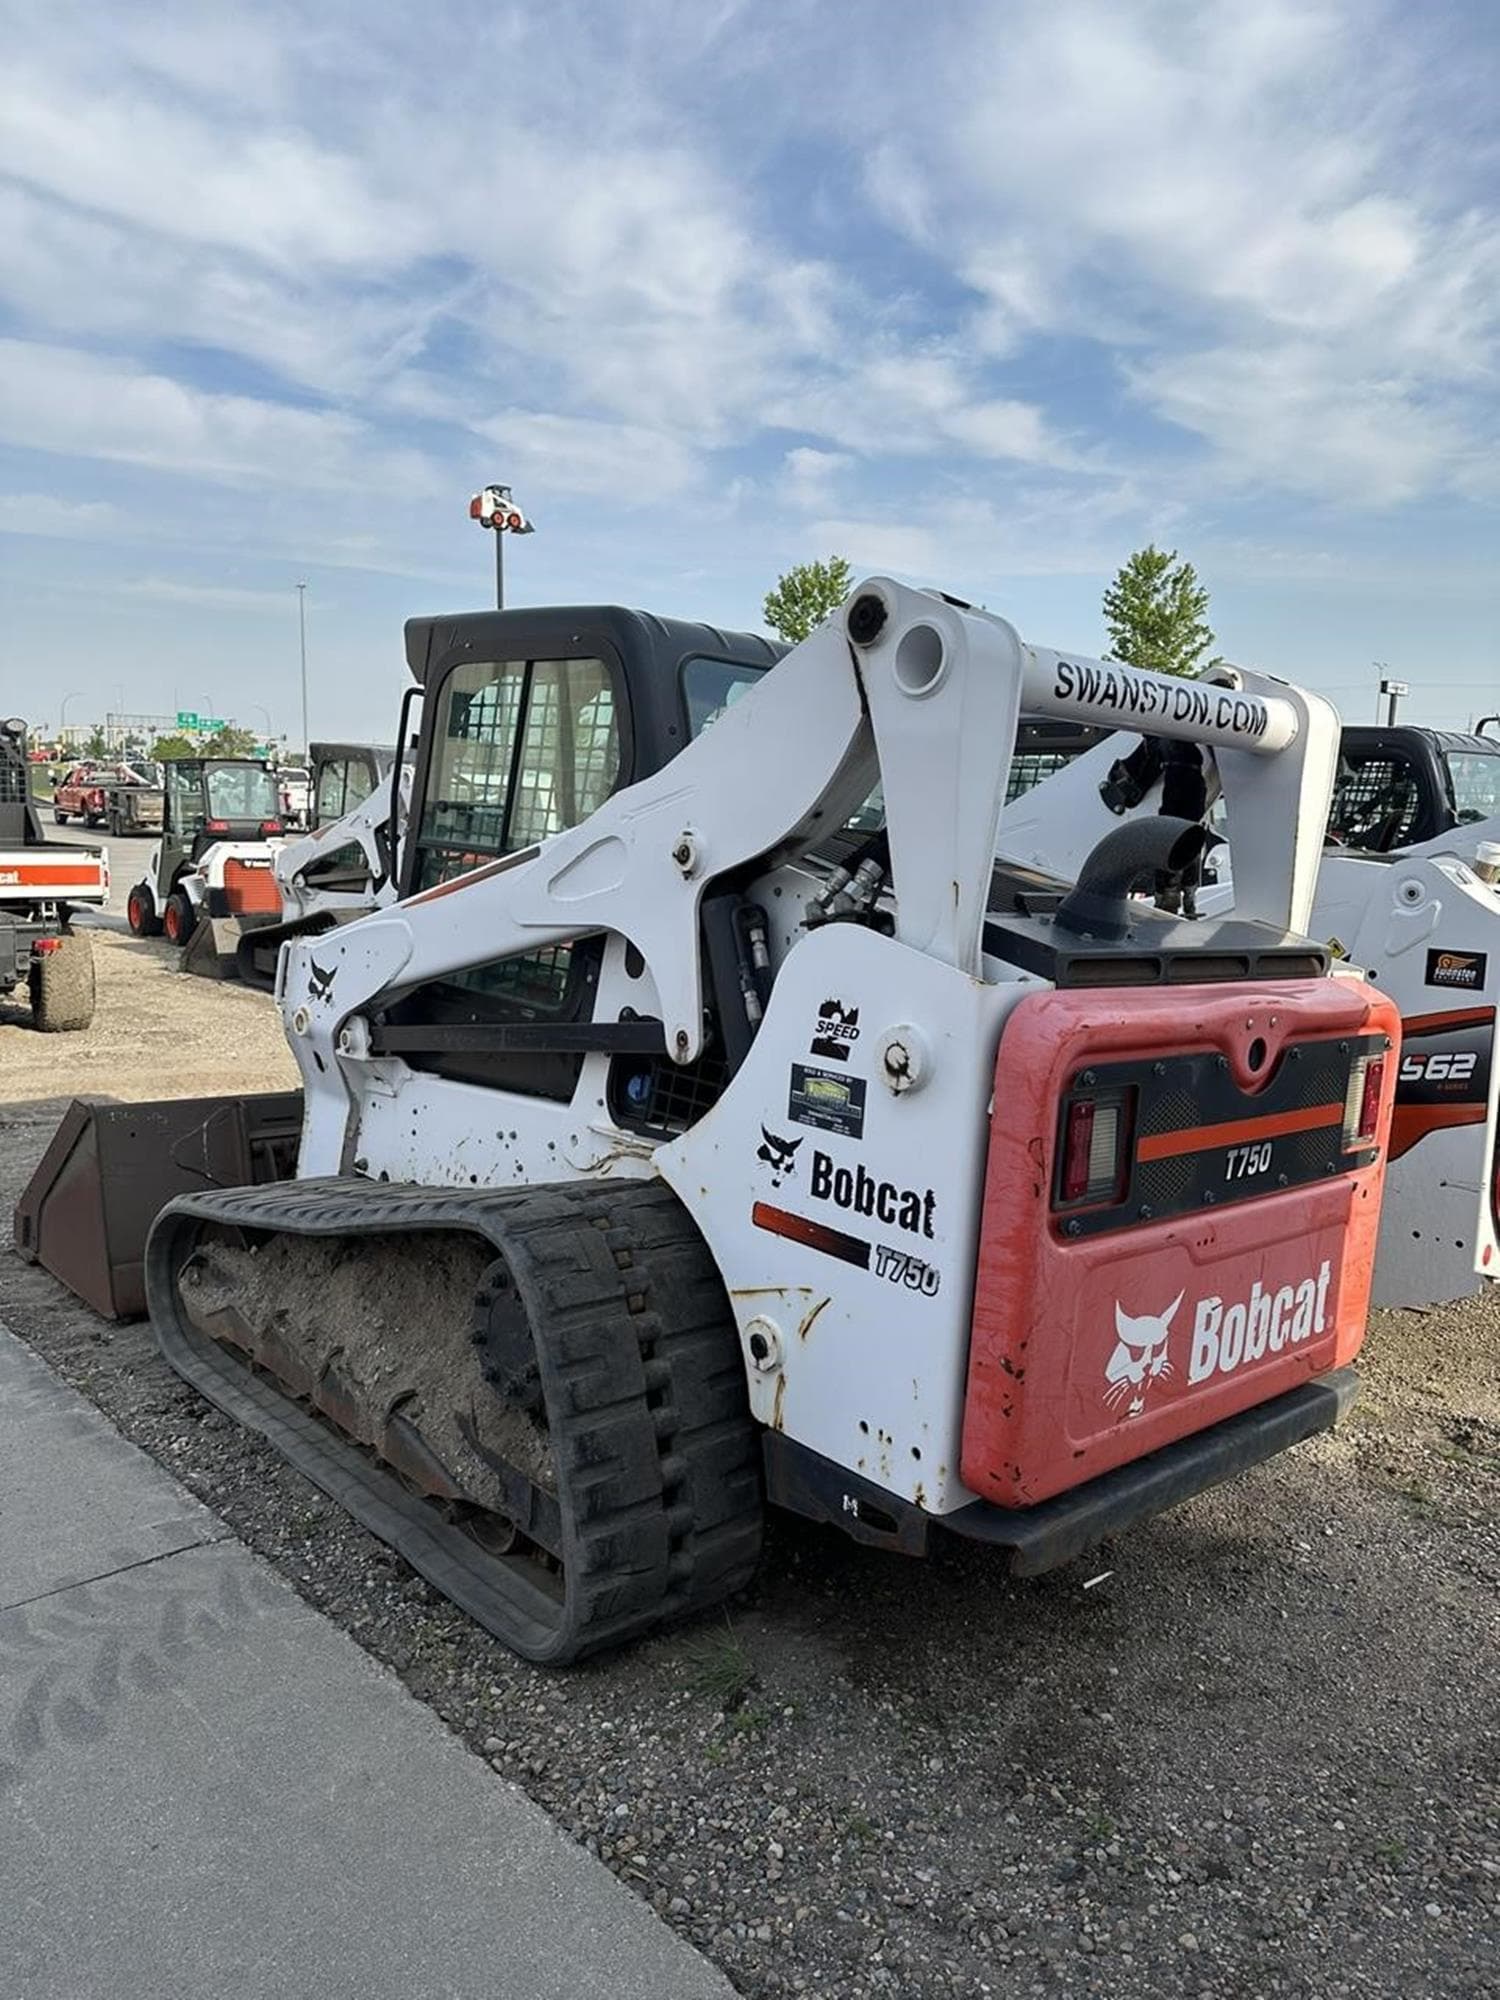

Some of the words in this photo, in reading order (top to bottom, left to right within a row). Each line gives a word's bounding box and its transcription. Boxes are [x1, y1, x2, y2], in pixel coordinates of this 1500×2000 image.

[1054, 661, 1268, 736] SWANSTON.COM
[815, 1020, 860, 1040] SPEED
[1400, 1053, 1478, 1080] S62
[1226, 1142, 1273, 1181] T750
[811, 1150, 937, 1240] Bobcat
[875, 1244, 941, 1297] T750
[1188, 1260, 1331, 1386] Bobcat
